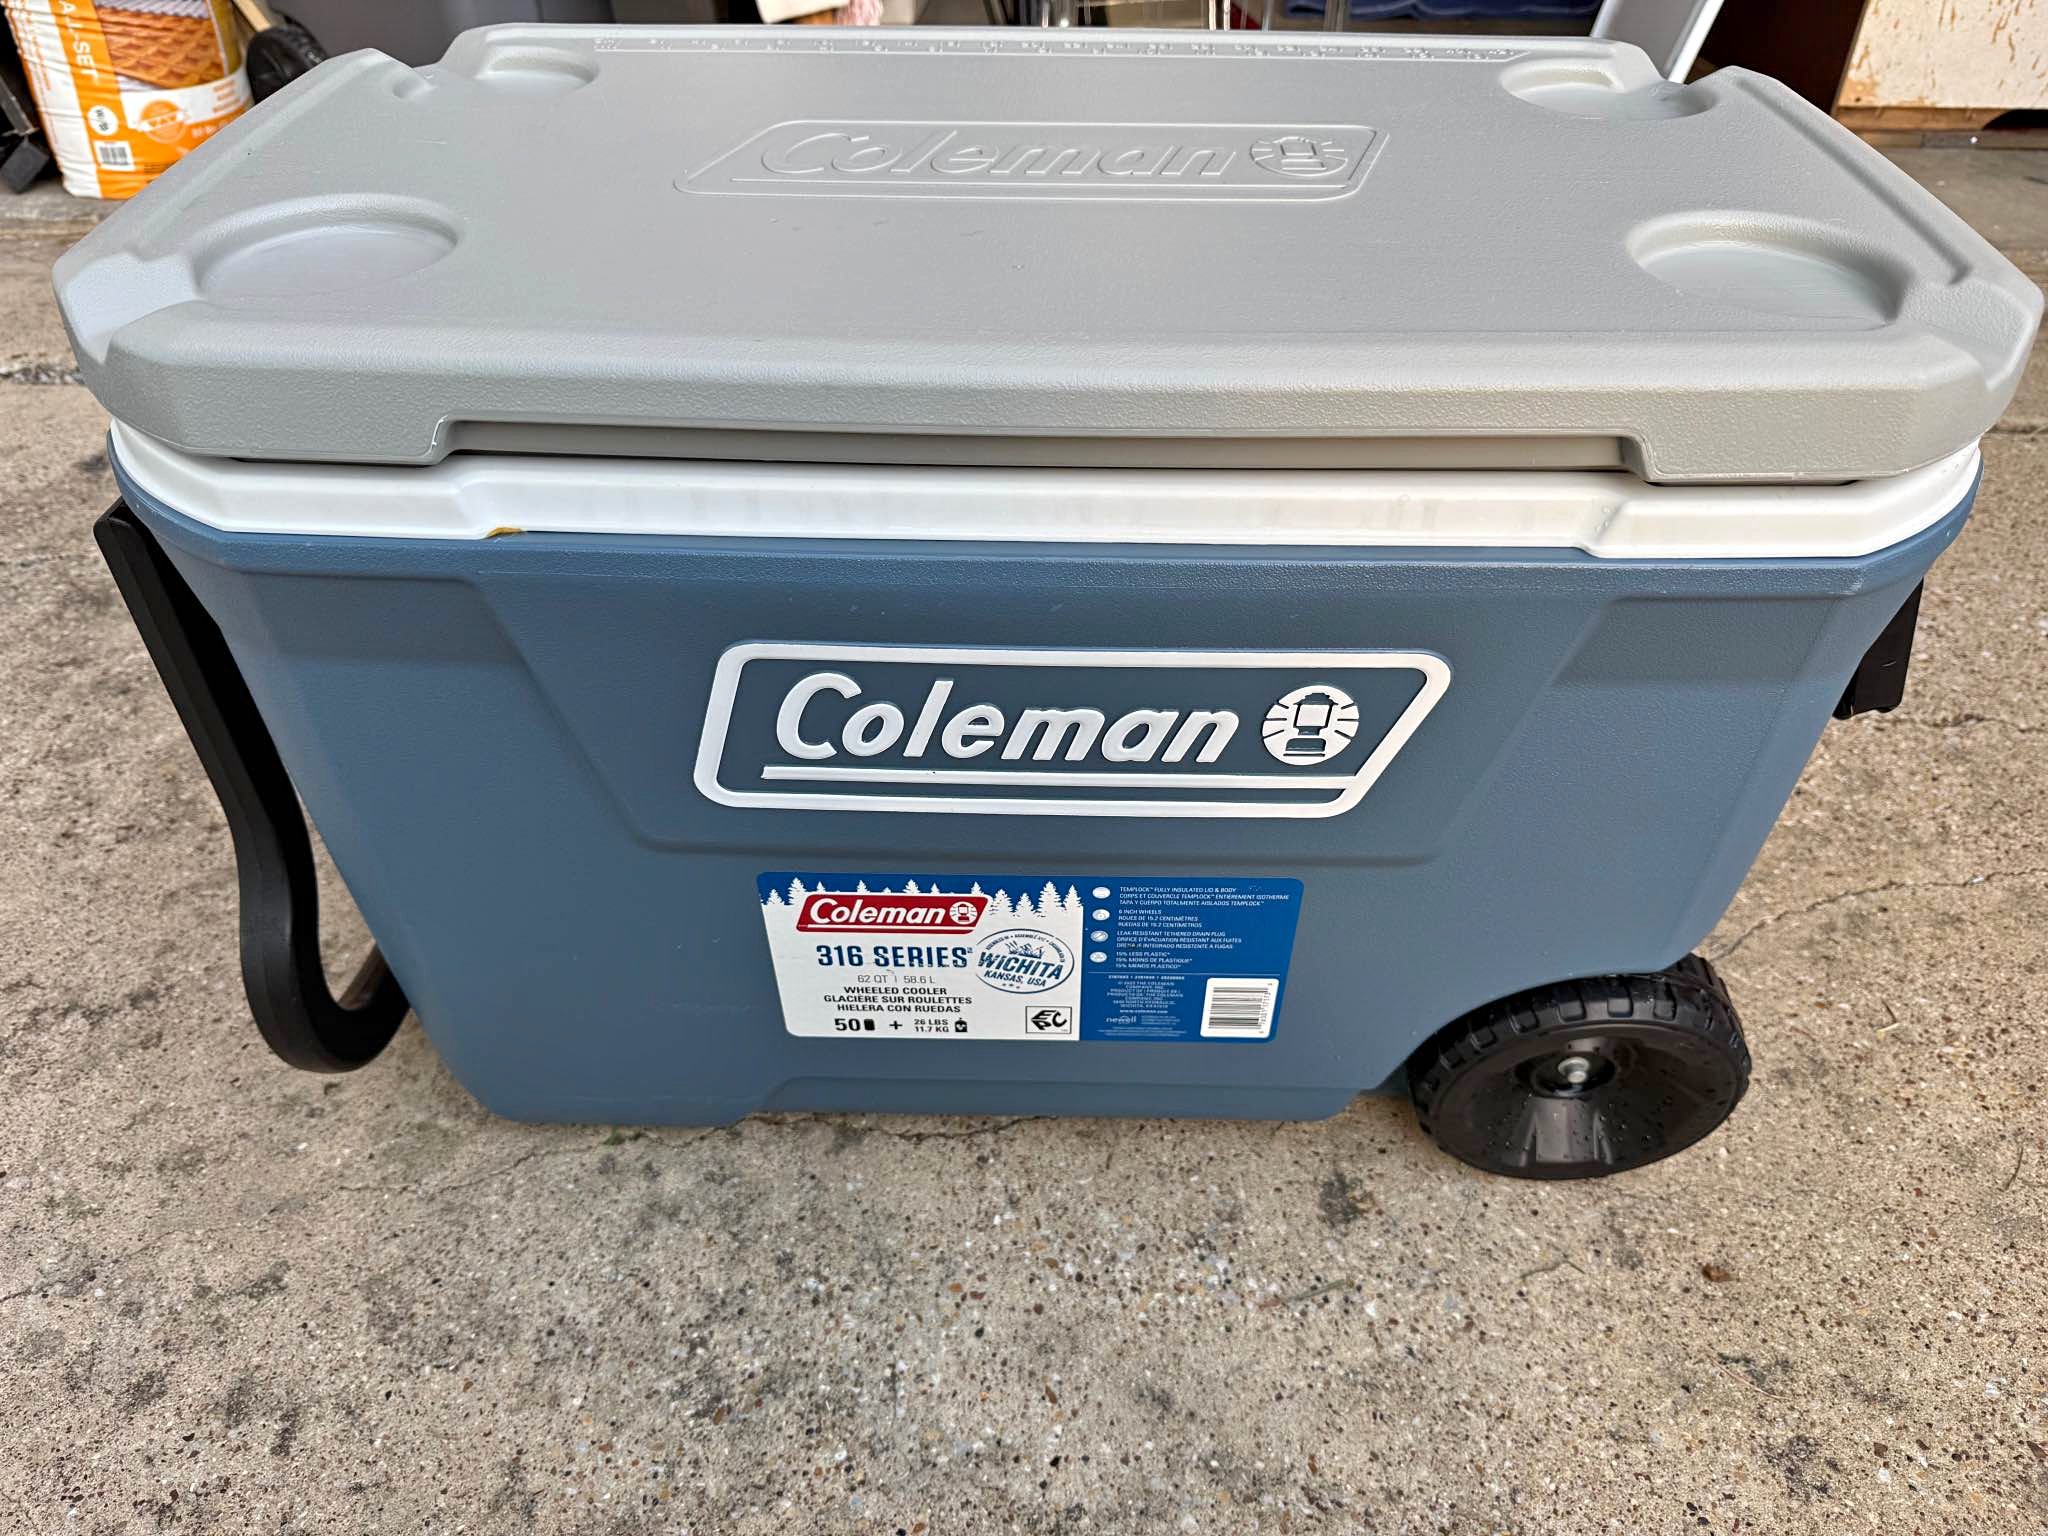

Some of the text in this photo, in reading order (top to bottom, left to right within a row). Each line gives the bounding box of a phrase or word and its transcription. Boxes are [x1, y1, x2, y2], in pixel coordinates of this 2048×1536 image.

[761, 129, 1238, 176] Coleman
[775, 672, 1240, 764] Coleman
[809, 896, 946, 926] Coleman
[815, 944, 864, 967] 316
[977, 951, 1064, 980] WICHITA
[857, 974, 871, 983] 62
[874, 974, 888, 984] QT
[903, 975, 927, 984] 58.6
[929, 976, 936, 984] L
[983, 969, 1047, 987] KANSAS, USA
[844, 986, 947, 995] WHEELED COOLER
[837, 1004, 961, 1013] HIELERA CON RUEDAS
[881, 996, 906, 1004] SUR
[908, 996, 973, 1005] ROULETTES
[834, 1018, 861, 1031] 50
